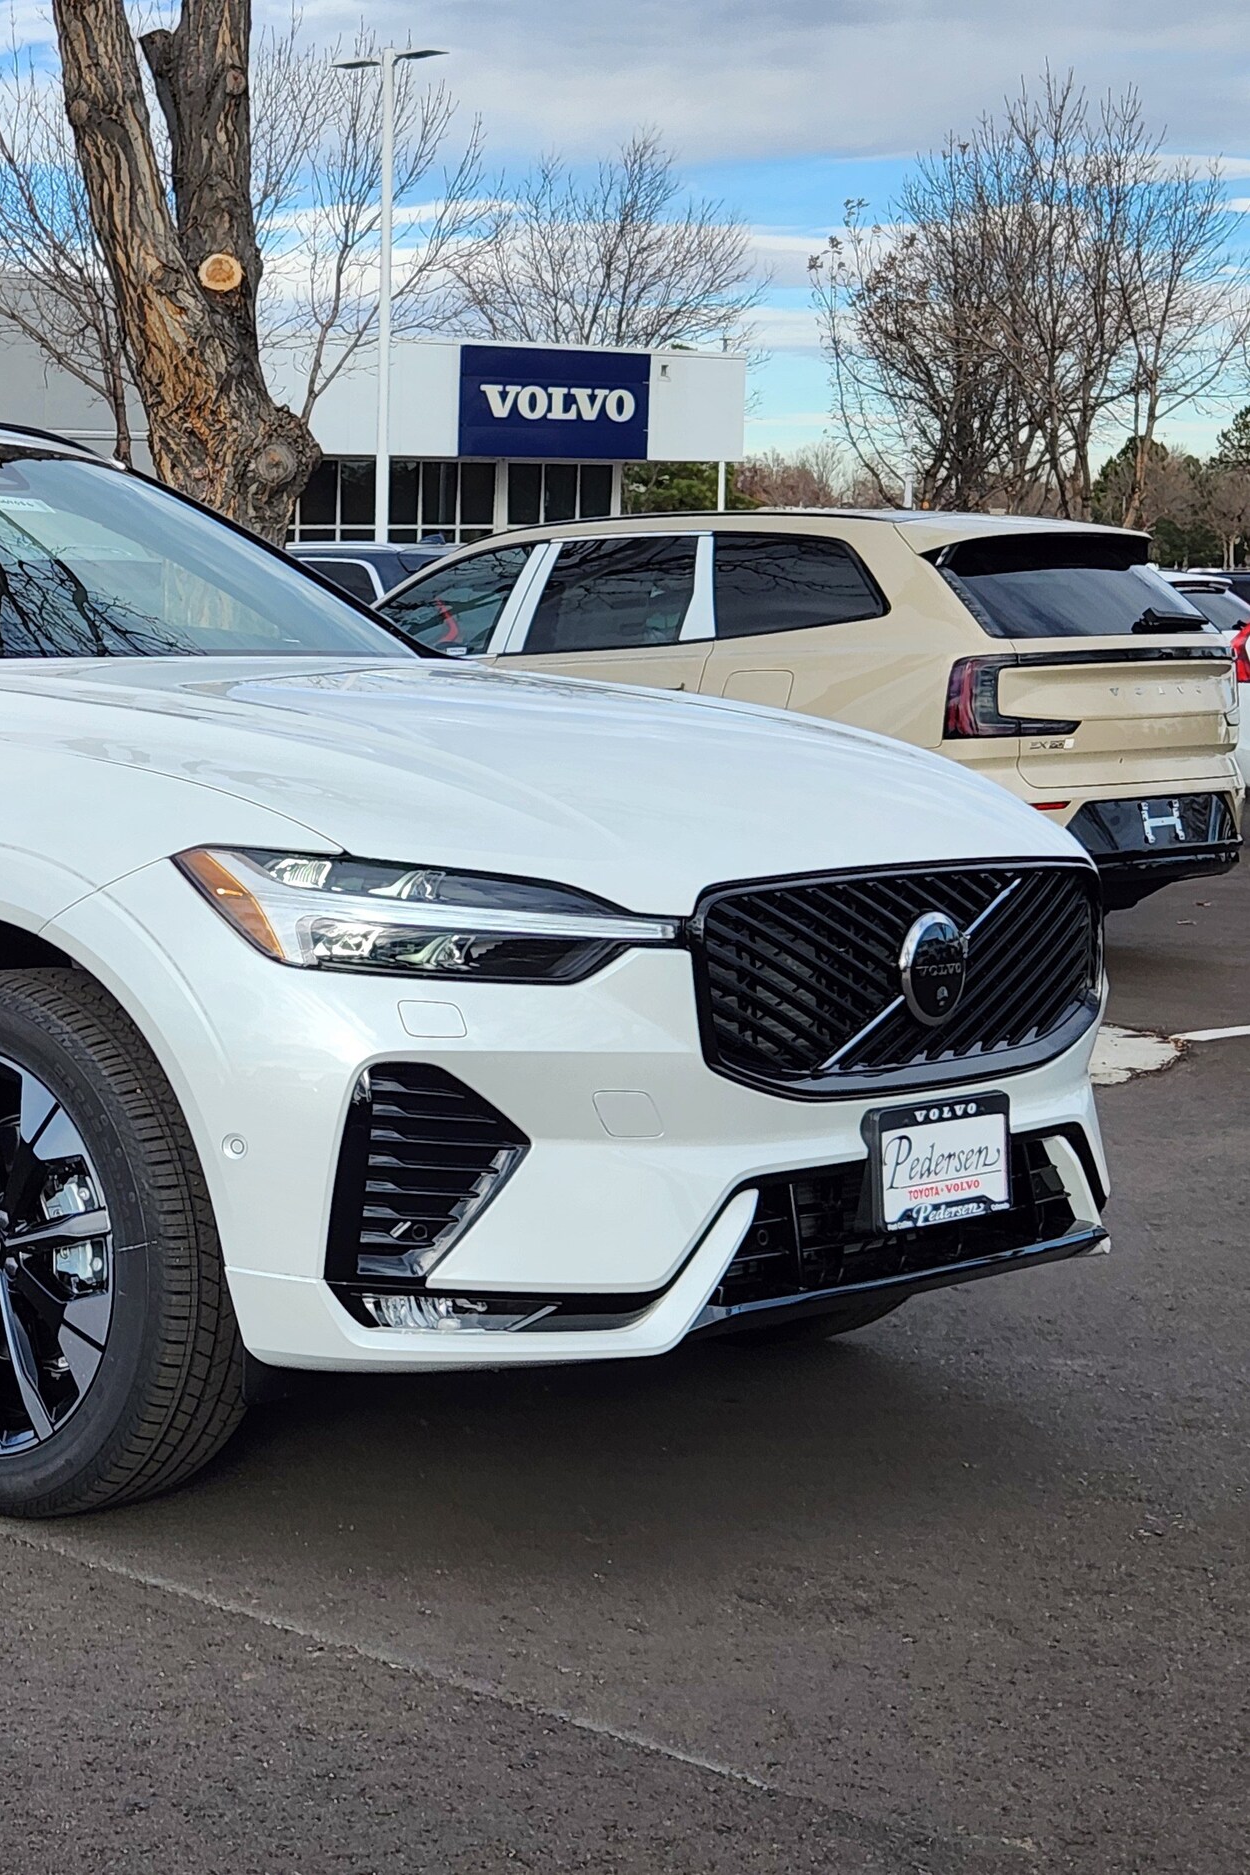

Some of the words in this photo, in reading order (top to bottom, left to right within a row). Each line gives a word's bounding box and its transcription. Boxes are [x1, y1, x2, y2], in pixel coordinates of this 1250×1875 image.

[479, 383, 636, 422] VOLVO
[914, 1102, 977, 1122] VOLVO
[883, 1134, 1001, 1191] Pedersen
[908, 1186, 940, 1201] TOYOTA
[944, 1179, 980, 1194] VOLVO
[912, 1202, 985, 1226] Pedersen
